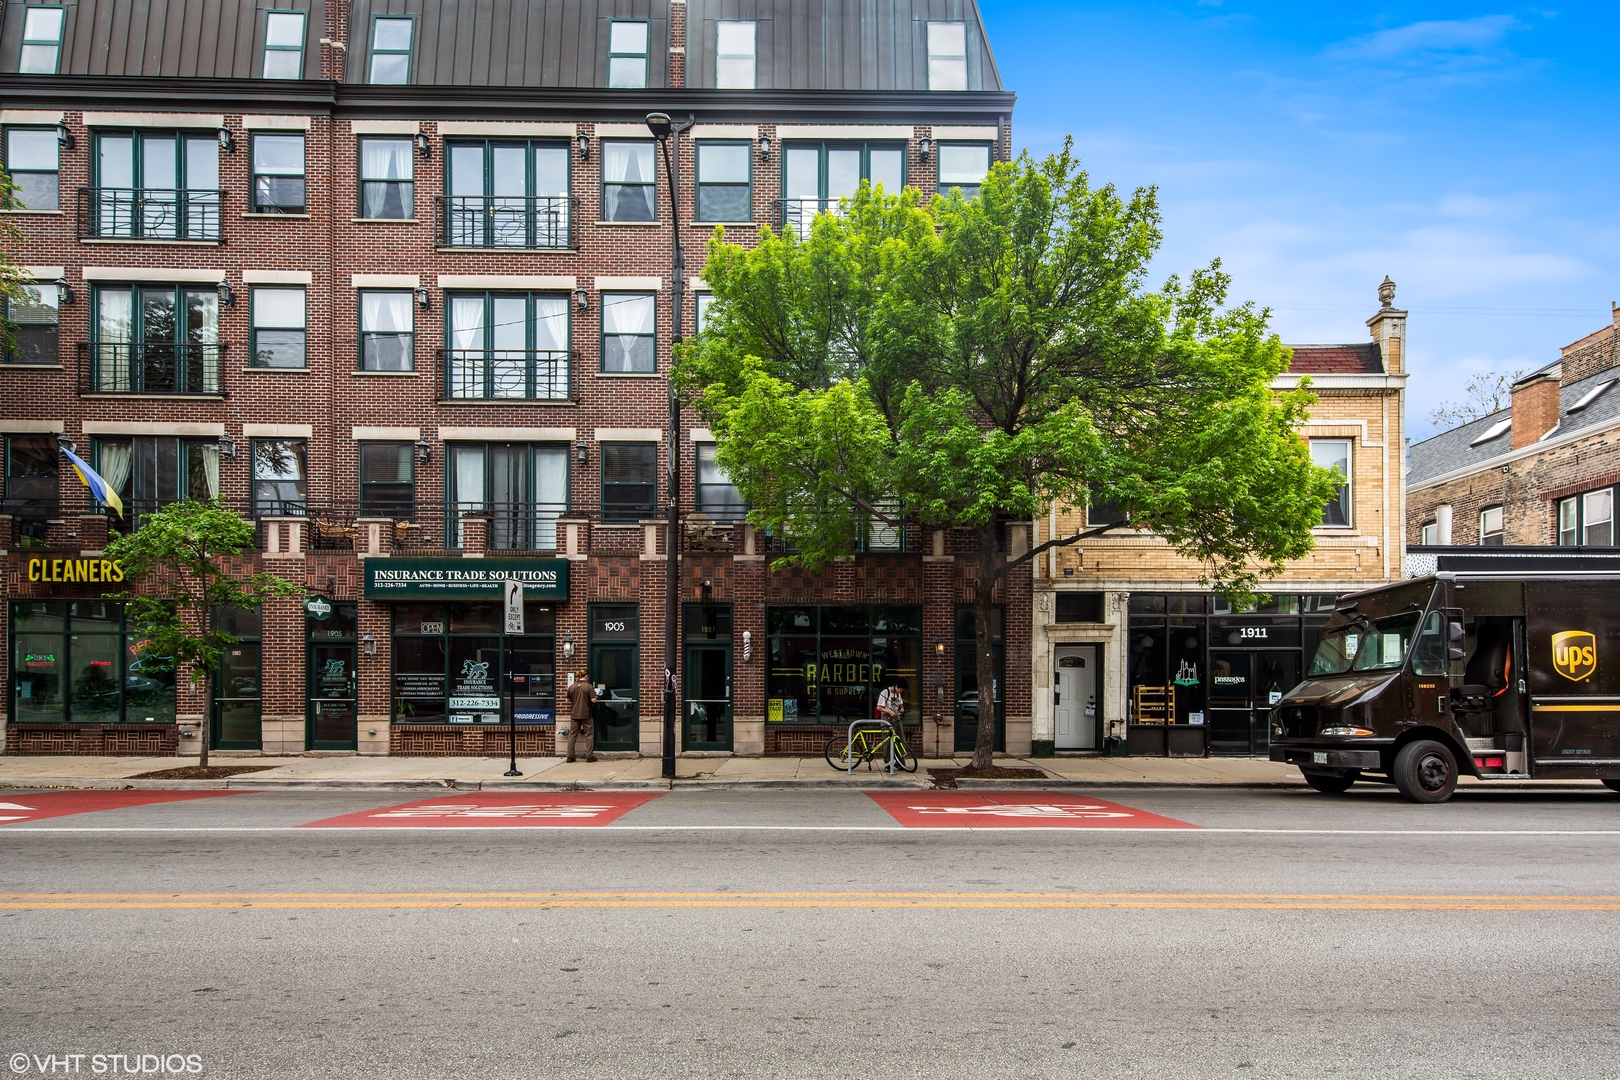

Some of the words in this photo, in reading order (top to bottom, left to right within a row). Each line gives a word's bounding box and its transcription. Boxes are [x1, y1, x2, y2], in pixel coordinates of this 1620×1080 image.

[28, 558, 124, 582] CLEANERS
[374, 571, 443, 580] INSURANCE
[446, 571, 486, 580] TRADE
[489, 571, 556, 580] SOLUTIONS
[309, 603, 329, 611] INSURANCE
[508, 613, 521, 621] EXCEPT
[422, 623, 442, 633] OPEN
[605, 622, 624, 632] 1905
[1240, 628, 1268, 638] 1911
[821, 649, 842, 659] WEST
[845, 649, 868, 659] TOWN
[1556, 646, 1593, 673] ups
[1214, 676, 1245, 684] passages
